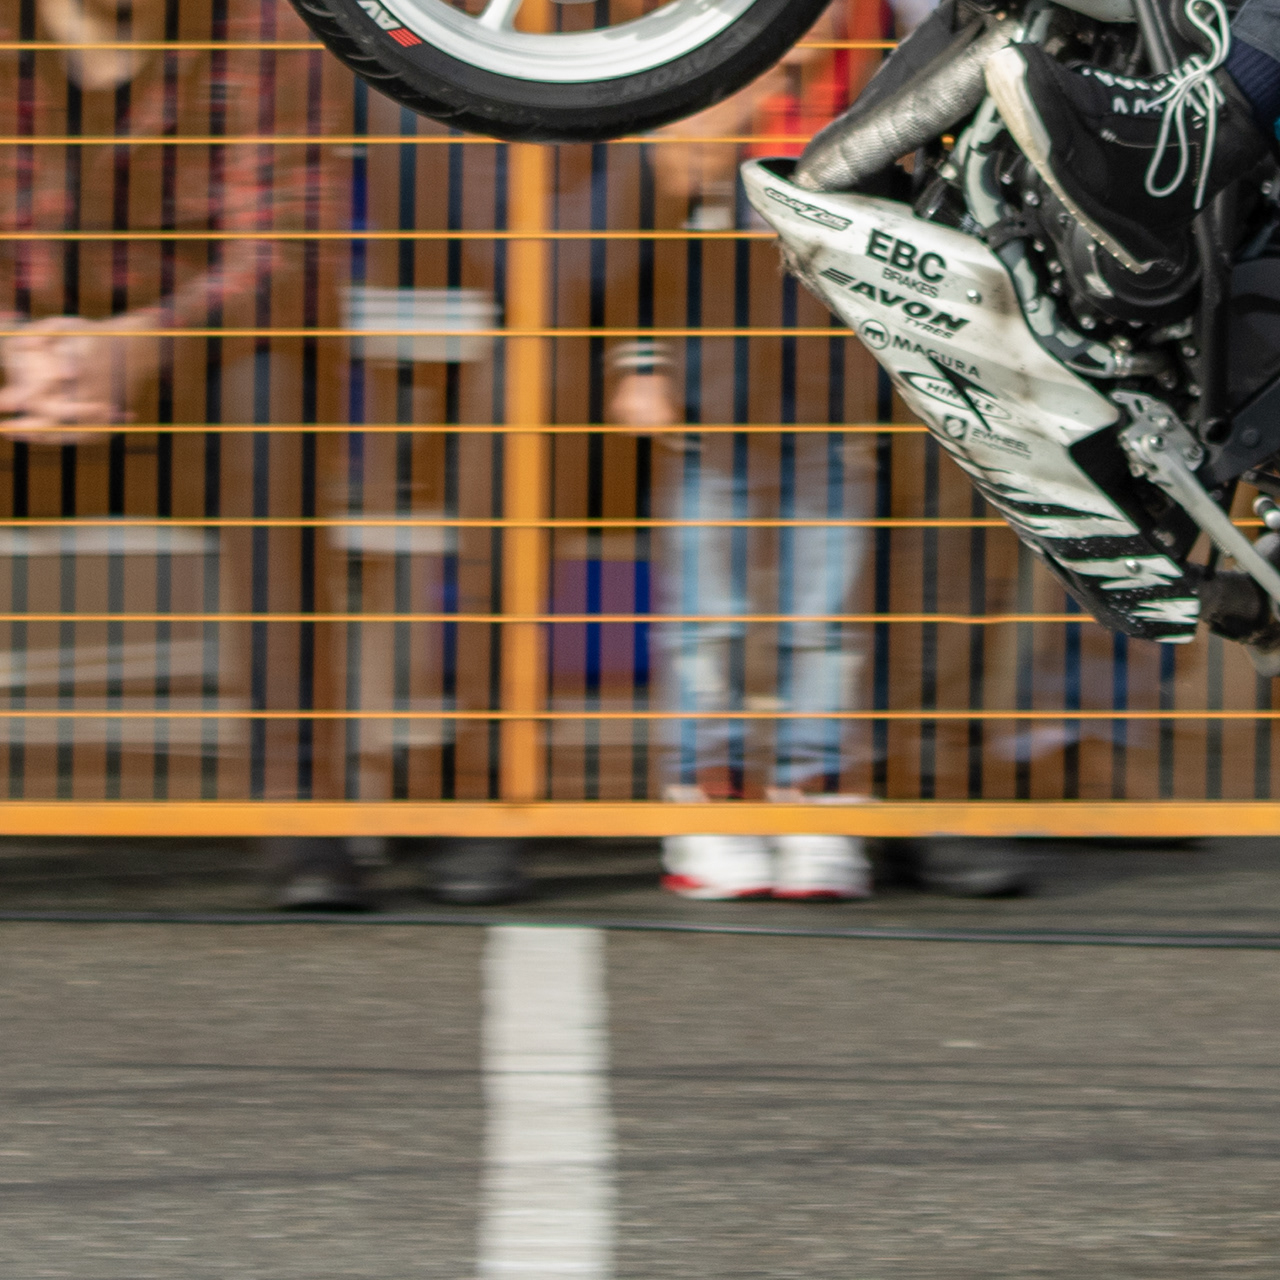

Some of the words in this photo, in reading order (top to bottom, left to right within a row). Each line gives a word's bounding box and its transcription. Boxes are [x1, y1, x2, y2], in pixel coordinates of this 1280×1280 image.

[865, 228, 947, 283] EBC
[882, 267, 939, 299] BRAKES
[848, 281, 971, 332] AVON
[904, 317, 955, 339] TYRES
[892, 335, 982, 379] MAGURA
[926, 381, 995, 411] HINLE
